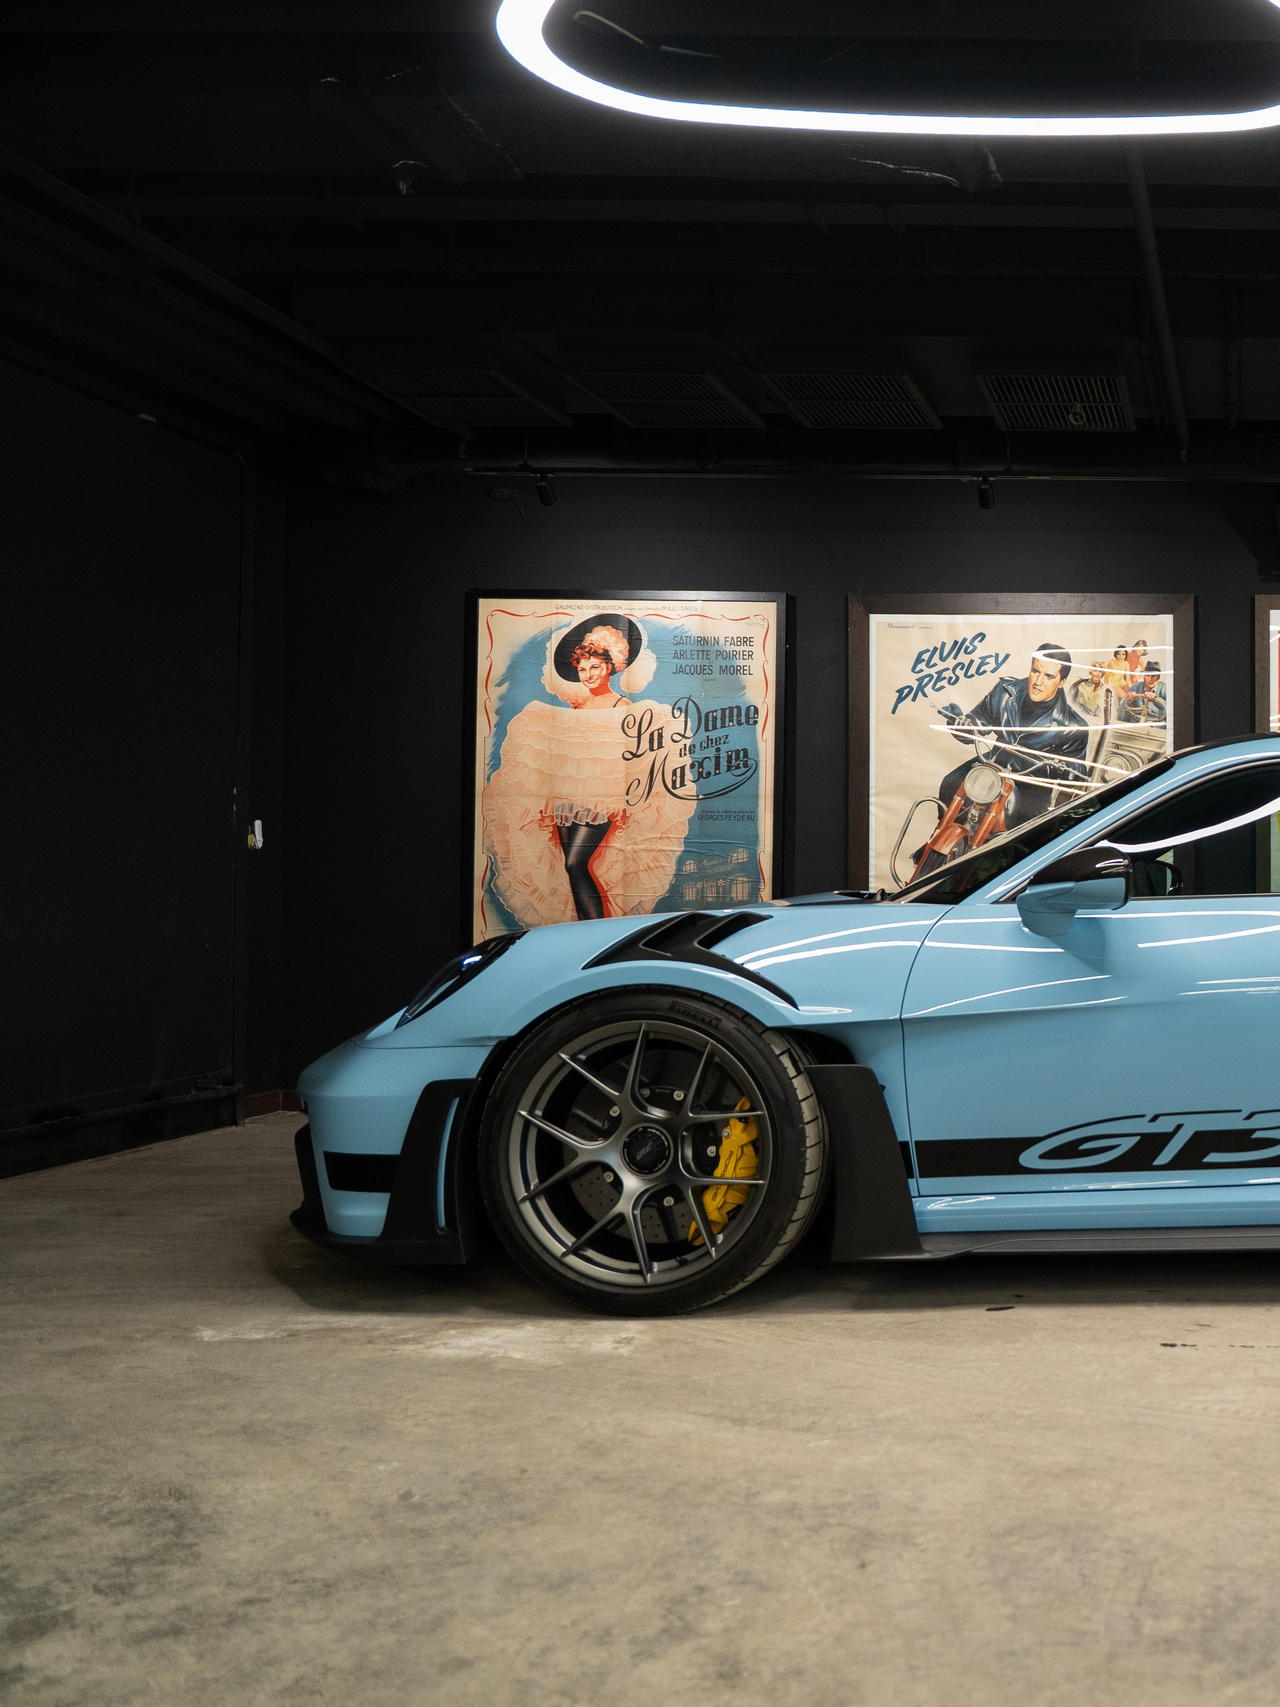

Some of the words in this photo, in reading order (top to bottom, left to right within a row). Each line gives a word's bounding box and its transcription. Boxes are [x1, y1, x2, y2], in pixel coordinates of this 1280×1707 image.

[673, 635, 720, 647] SATURNIN
[724, 636, 754, 647] FABRE
[911, 632, 987, 674] ELVIS
[672, 649, 711, 660] ARLETTE
[715, 649, 754, 661] POIRIER
[672, 664, 714, 676] JACQUES
[719, 664, 753, 675] MOREL
[891, 652, 1011, 715] PRESLEY
[621, 708, 665, 761] La
[670, 695, 759, 743] Dame
[679, 743, 696, 757] de
[699, 733, 730, 751] chez
[625, 747, 758, 806] Maxim
[697, 813, 725, 821] GEORGES
[669, 1000, 722, 1029] PIRELLI
